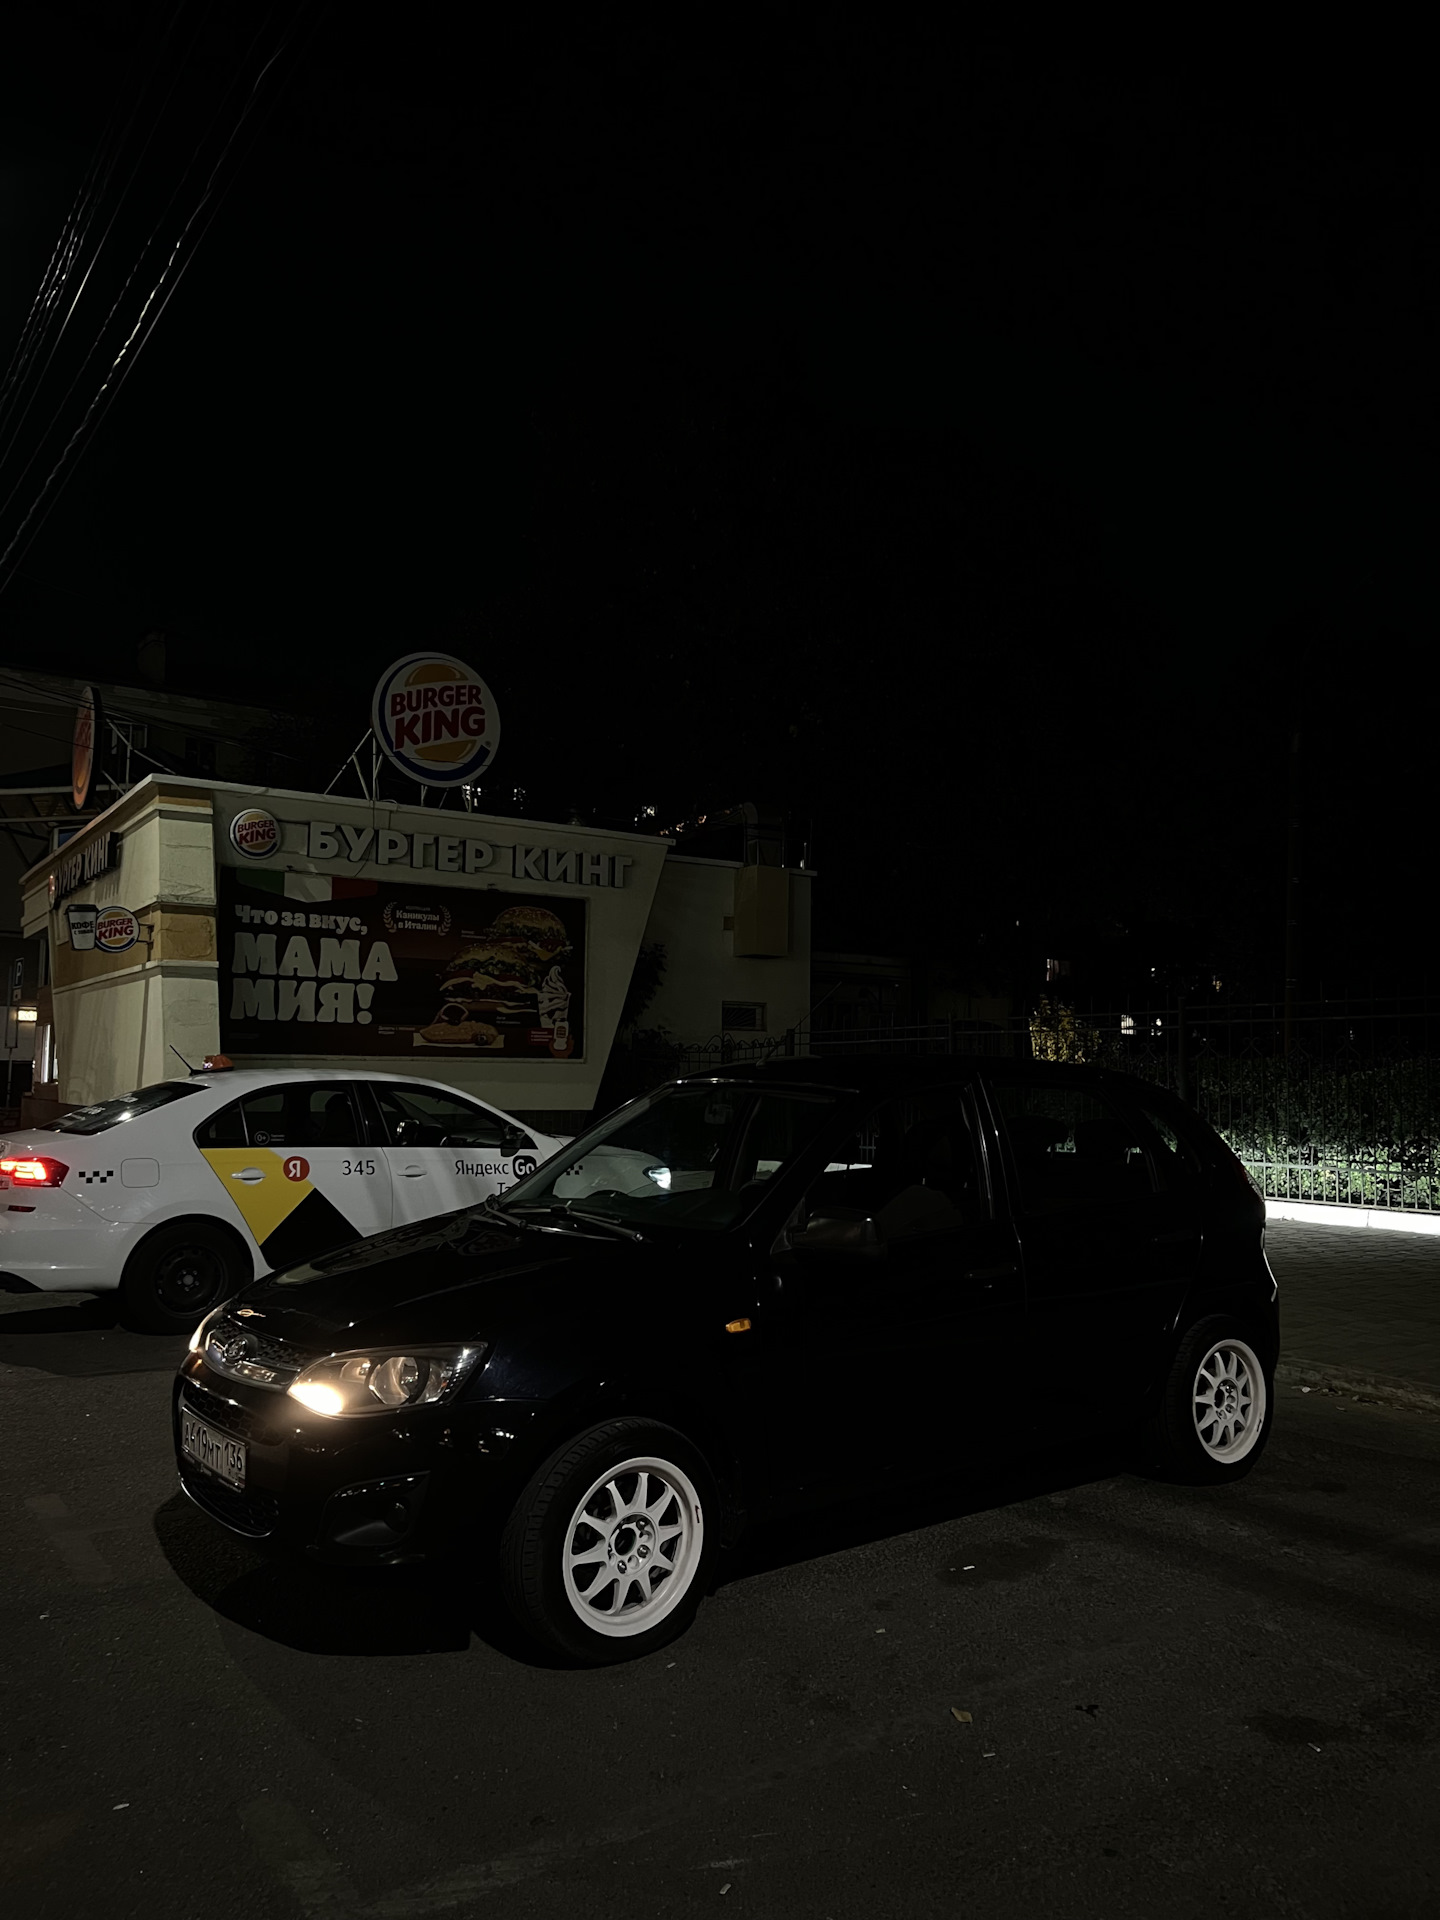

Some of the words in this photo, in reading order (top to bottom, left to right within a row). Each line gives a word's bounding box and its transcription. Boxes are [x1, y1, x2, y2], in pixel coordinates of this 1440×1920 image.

[390, 685, 481, 717] BURGER
[392, 706, 486, 751] KING
[236, 819, 275, 834] BURGER
[238, 827, 276, 846] KING
[309, 821, 495, 874] БУРГЕР
[512, 843, 633, 889] КИНГ
[71, 920, 95, 929] КОФЕ
[97, 918, 133, 930] BURGER
[234, 904, 278, 926] Что
[280, 911, 307, 928] за
[308, 913, 368, 936] вкус,
[395, 910, 440, 922] Каникулы
[98, 925, 134, 941] KING
[398, 921, 404, 929] в
[404, 920, 438, 931] Италии
[231, 932, 399, 982] МАМА
[229, 977, 375, 1025] МИЯ!
[342, 1160, 375, 1176] 345
[455, 1160, 509, 1177] Яндекс
